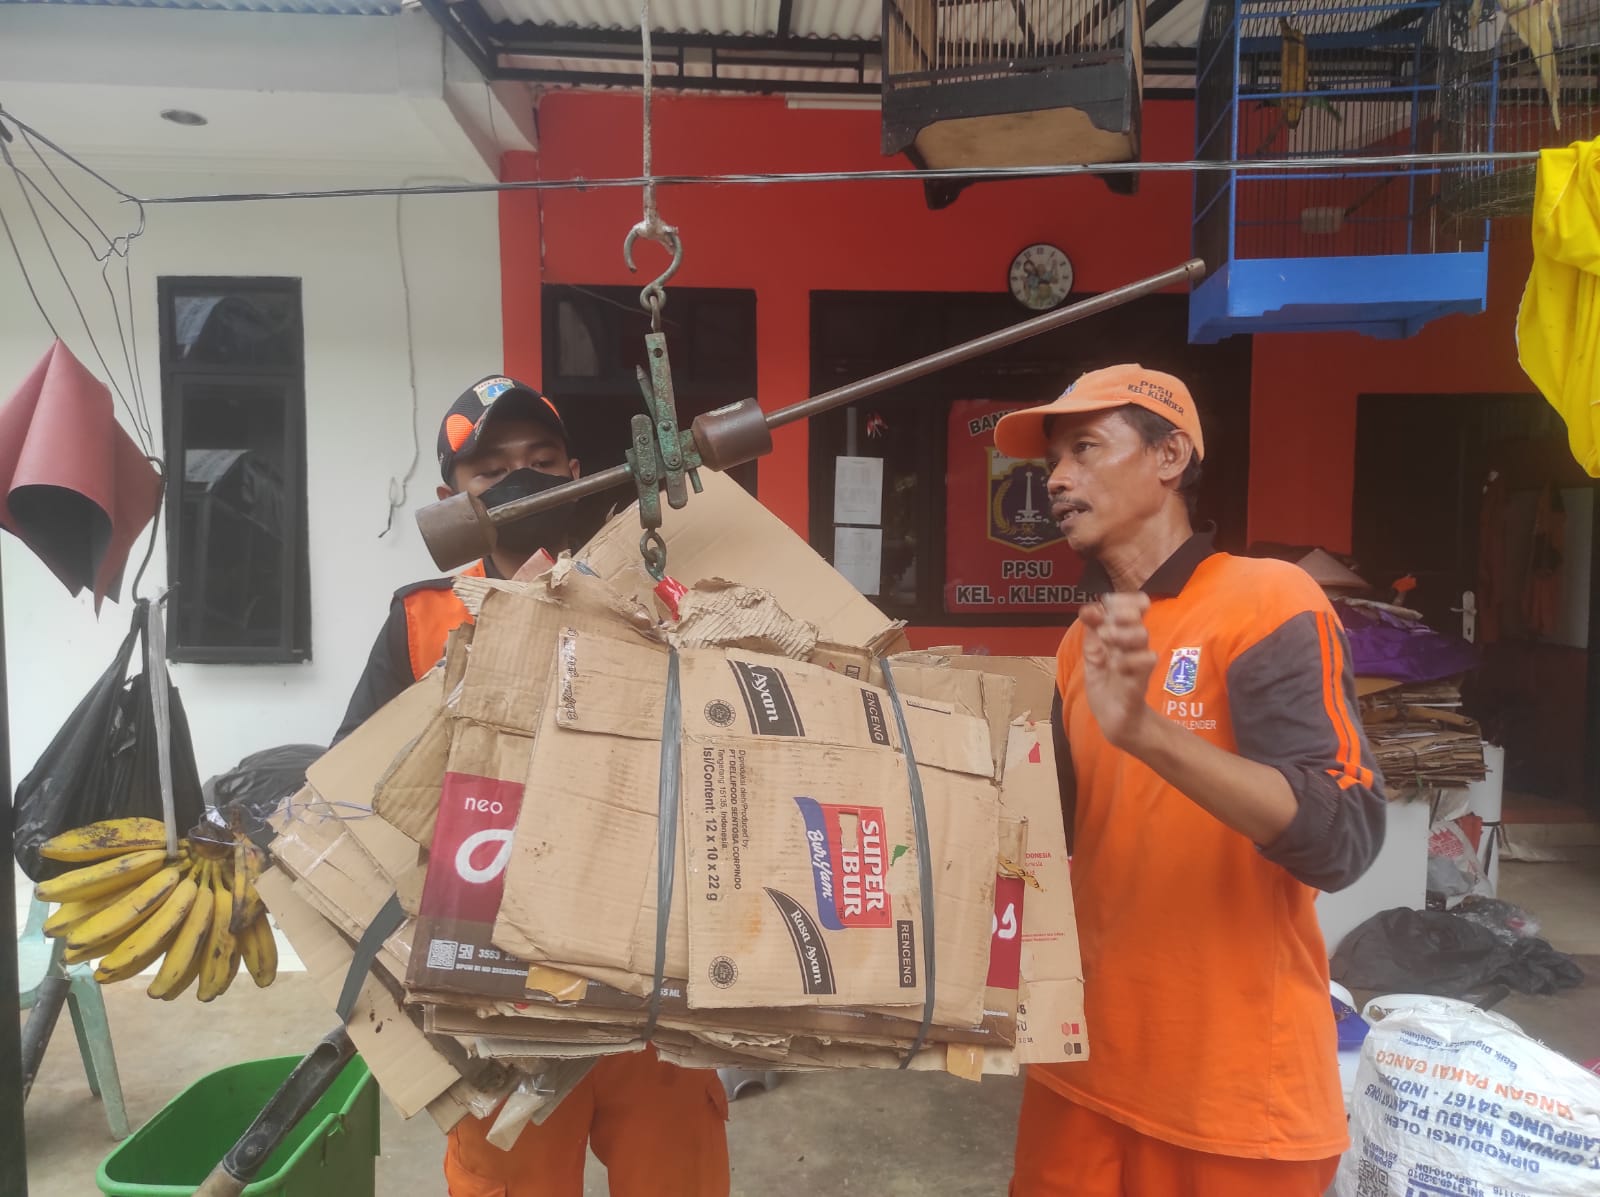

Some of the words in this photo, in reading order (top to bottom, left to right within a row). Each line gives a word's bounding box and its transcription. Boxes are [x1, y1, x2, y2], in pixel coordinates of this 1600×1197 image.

[1140, 380, 1173, 398] PPSU
[1002, 560, 1053, 579] PPSU
[1009, 585, 1097, 605] KLENDER
[751, 672, 779, 723] Ayam
[1166, 699, 1203, 718] PSU
[865, 691, 884, 741] ENCENG
[716, 749, 726, 783] Tangerang
[728, 749, 736, 760] PT
[703, 747, 716, 814] Isi/Content:
[729, 760, 738, 805] DELLIFOOD
[464, 797, 504, 815] neo
[705, 818, 717, 832] 12
[731, 806, 740, 845] SENTOSA
[706, 835, 716, 843] x
[707, 846, 719, 860] 10
[861, 820, 884, 912] SUPER
[707, 863, 717, 871] x
[732, 845, 742, 890] CORPINDO
[708, 875, 720, 889] 22
[706, 892, 717, 901] g
[790, 910, 810, 943] Rasa
[805, 944, 824, 985] Ayam
[901, 923, 913, 984] RENCENG
[669, 989, 681, 998] ML
[1431, 1063, 1489, 1090] PAKAI
[1443, 1091, 1503, 1119] 34167
[1436, 1109, 1494, 1138] MADU
[1426, 1127, 1540, 1174] DIPRODUKSI
[1501, 1128, 1585, 1166] GUNUNG
